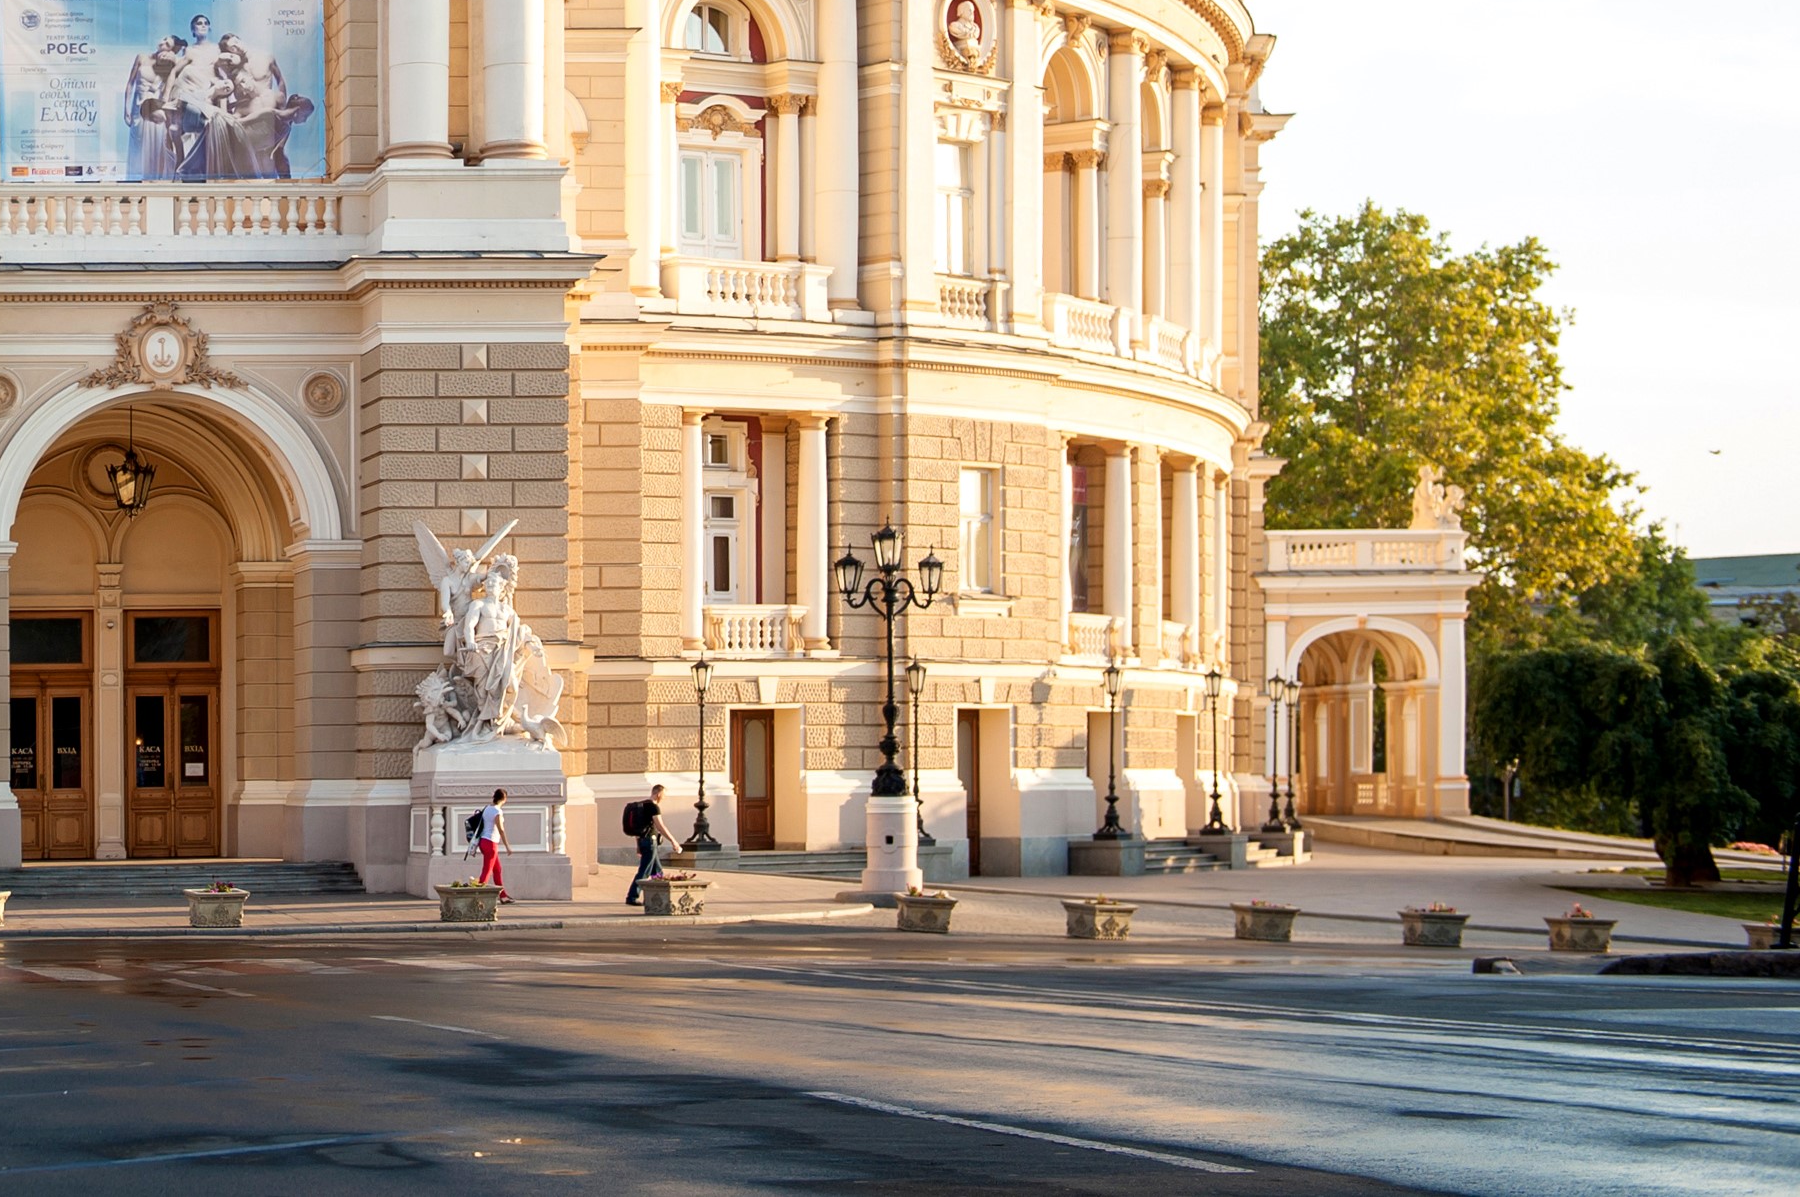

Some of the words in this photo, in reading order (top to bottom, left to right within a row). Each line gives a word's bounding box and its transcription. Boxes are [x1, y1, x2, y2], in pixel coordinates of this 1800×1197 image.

[286, 28, 306, 36] 19:00
[40, 88, 71, 99] своїм
[54, 99, 95, 111] серцем
[40, 107, 98, 127] Елладу
[11, 747, 33, 755] КАСА
